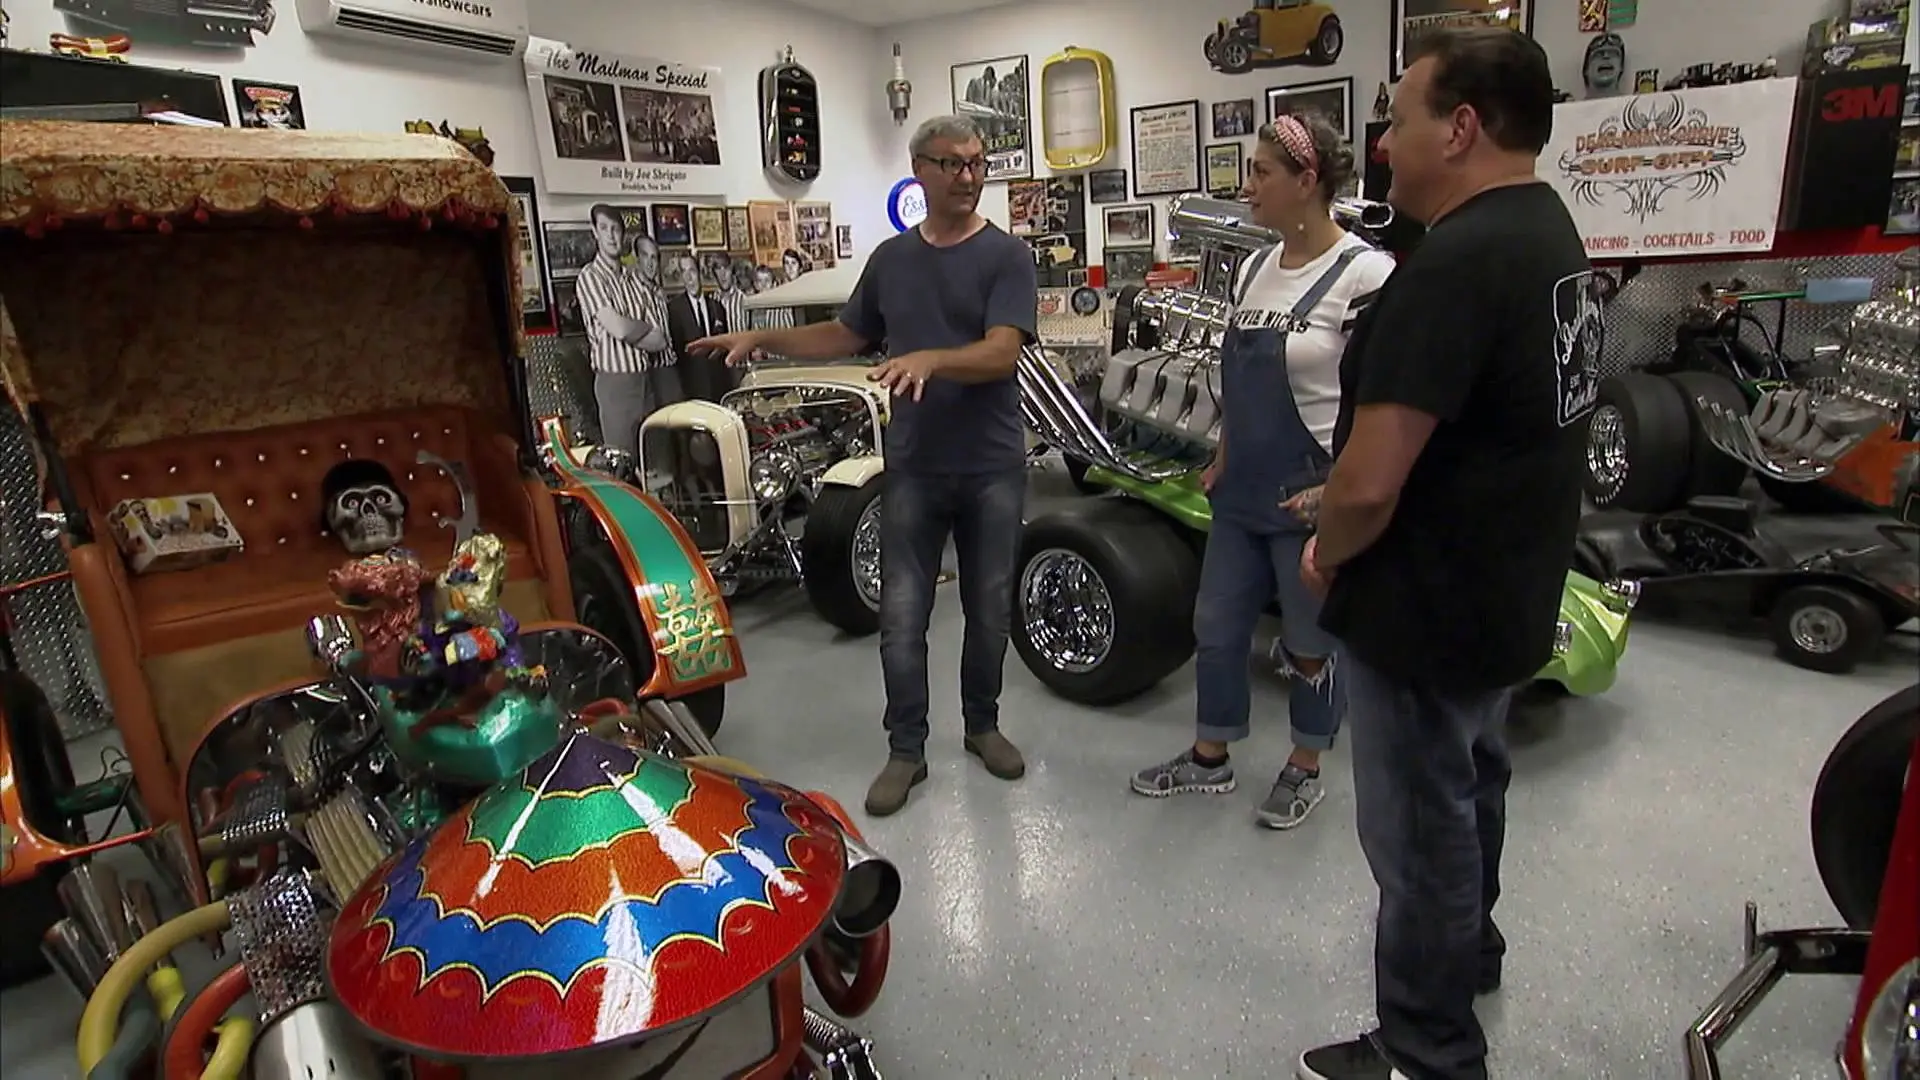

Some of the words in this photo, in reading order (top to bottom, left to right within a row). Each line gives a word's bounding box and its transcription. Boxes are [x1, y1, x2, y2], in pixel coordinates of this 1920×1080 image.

[540, 47, 571, 70] The
[575, 52, 650, 81] Mailman
[655, 64, 708, 89] Special
[1821, 84, 1900, 121] 3M
[601, 166, 623, 179] Built
[624, 167, 634, 181] by
[637, 167, 651, 180] Joe
[1578, 154, 1645, 175] SURF
[1653, 150, 1713, 170] CITY
[902, 194, 925, 218] Ess
[1583, 235, 1630, 250] ANCING
[1643, 231, 1715, 248] COCKTAILS
[1730, 229, 1766, 244] FOOD
